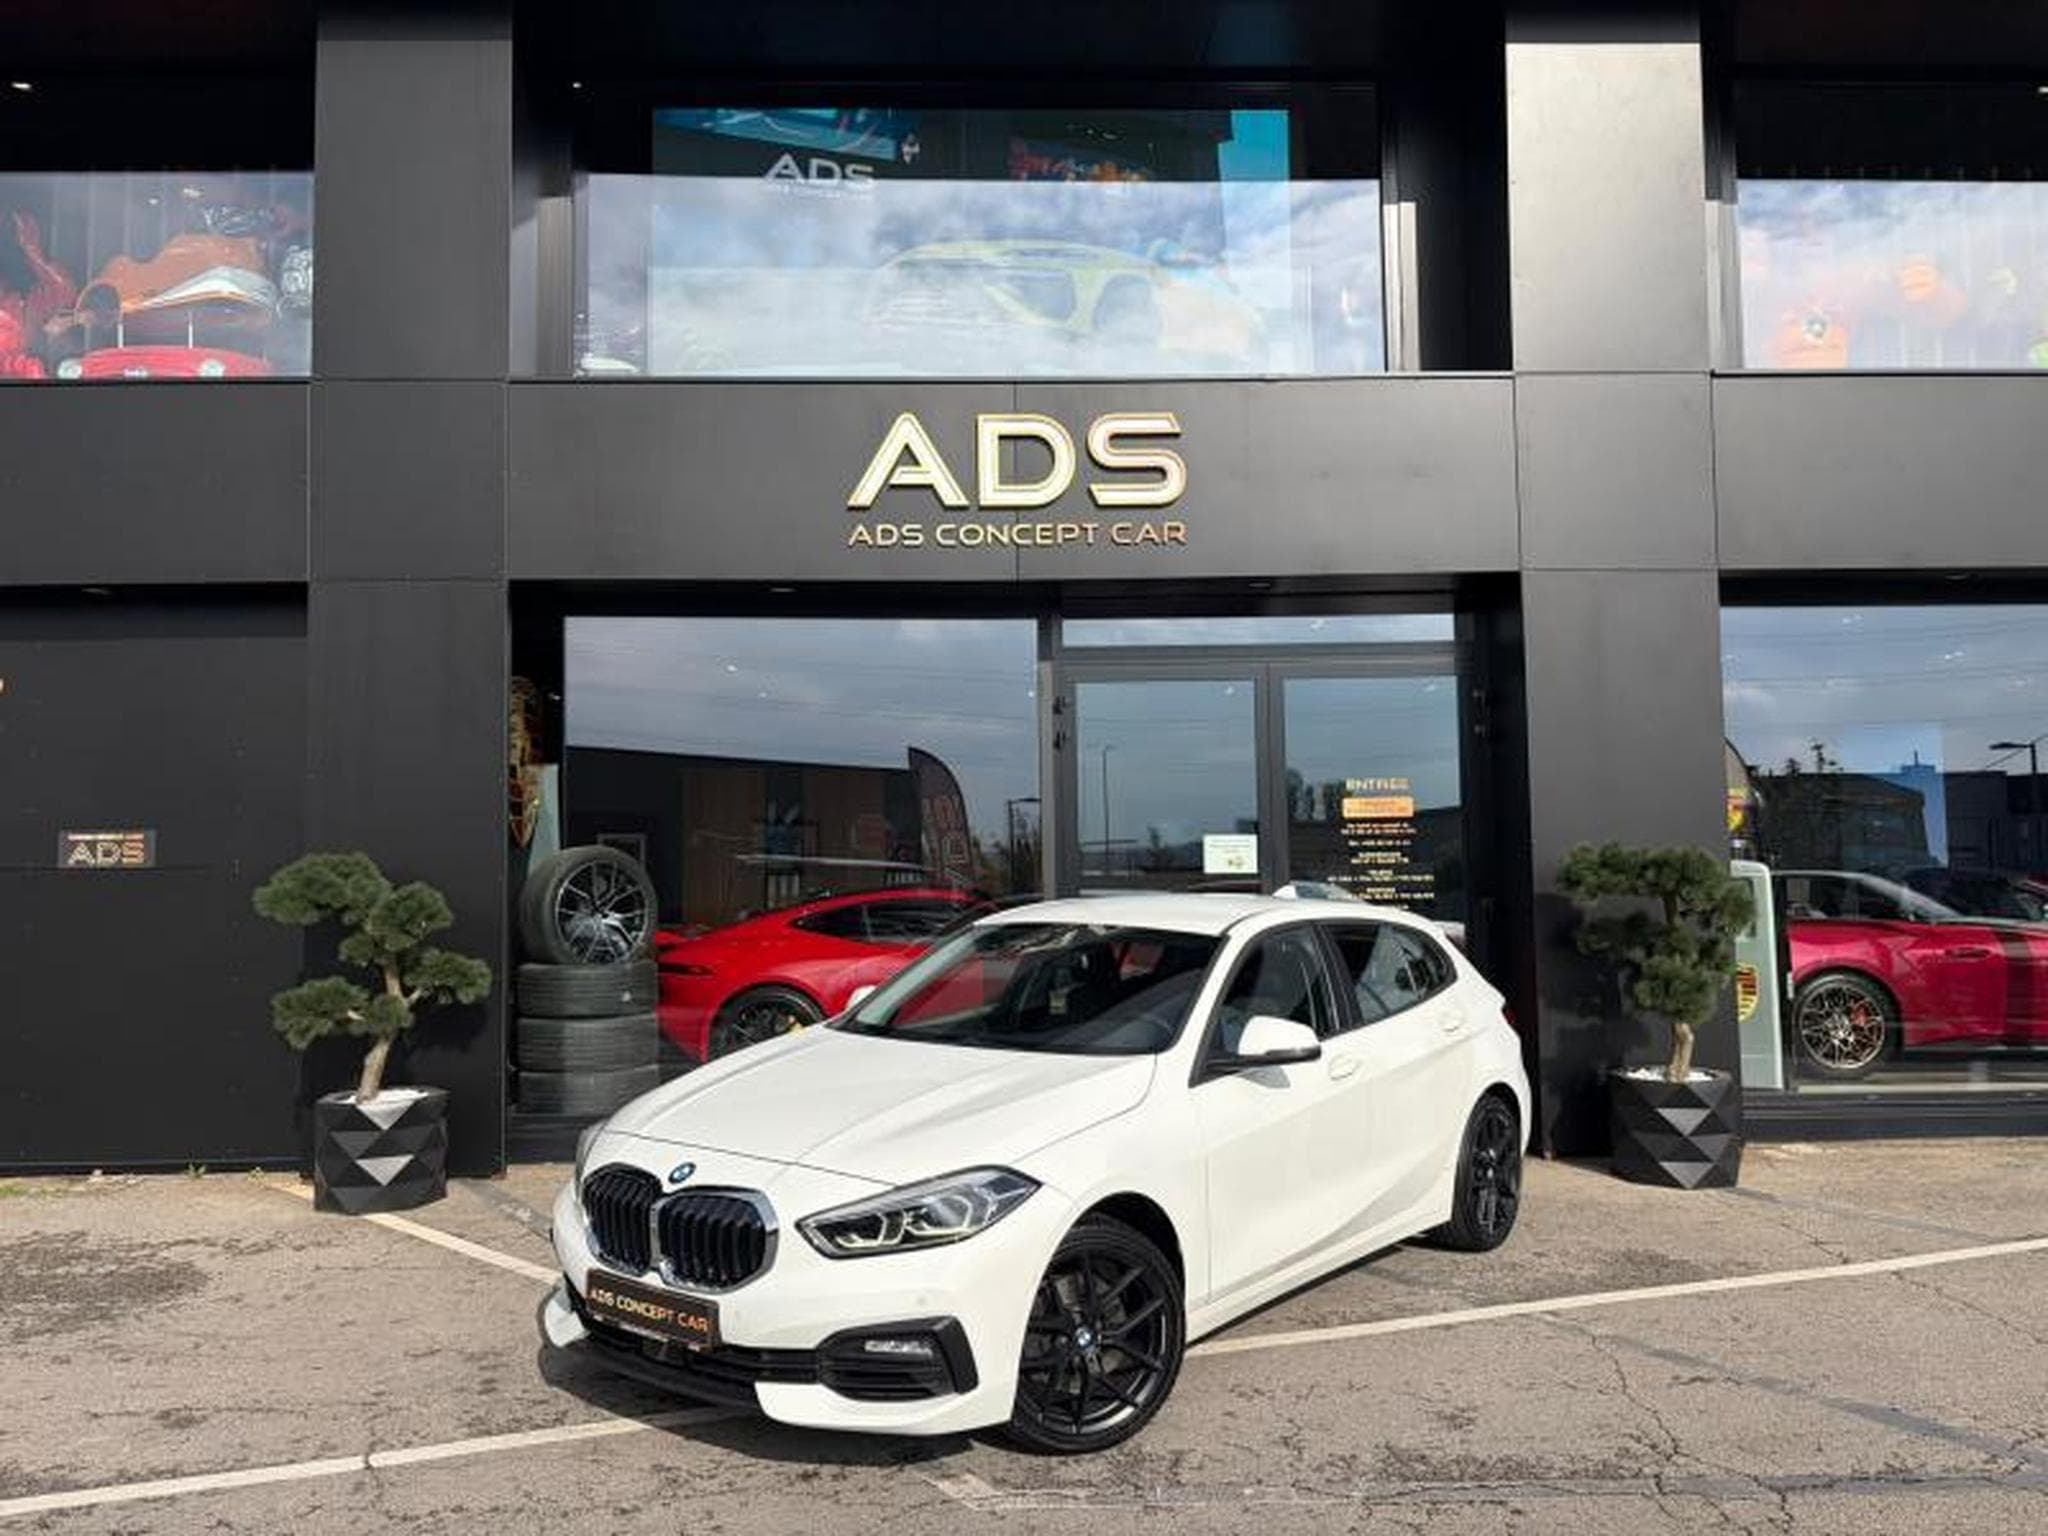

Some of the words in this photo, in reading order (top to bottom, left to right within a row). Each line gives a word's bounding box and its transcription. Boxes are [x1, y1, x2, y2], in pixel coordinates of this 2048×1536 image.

[763, 152, 876, 189] ADS
[847, 412, 1188, 509] ADS
[849, 522, 925, 546] ADS
[936, 522, 1099, 546] CONCEPT
[1110, 521, 1188, 545] CAR
[67, 842, 145, 864] ADS
[616, 1294, 674, 1321] CONCEPT
[676, 1311, 708, 1333] CAR
